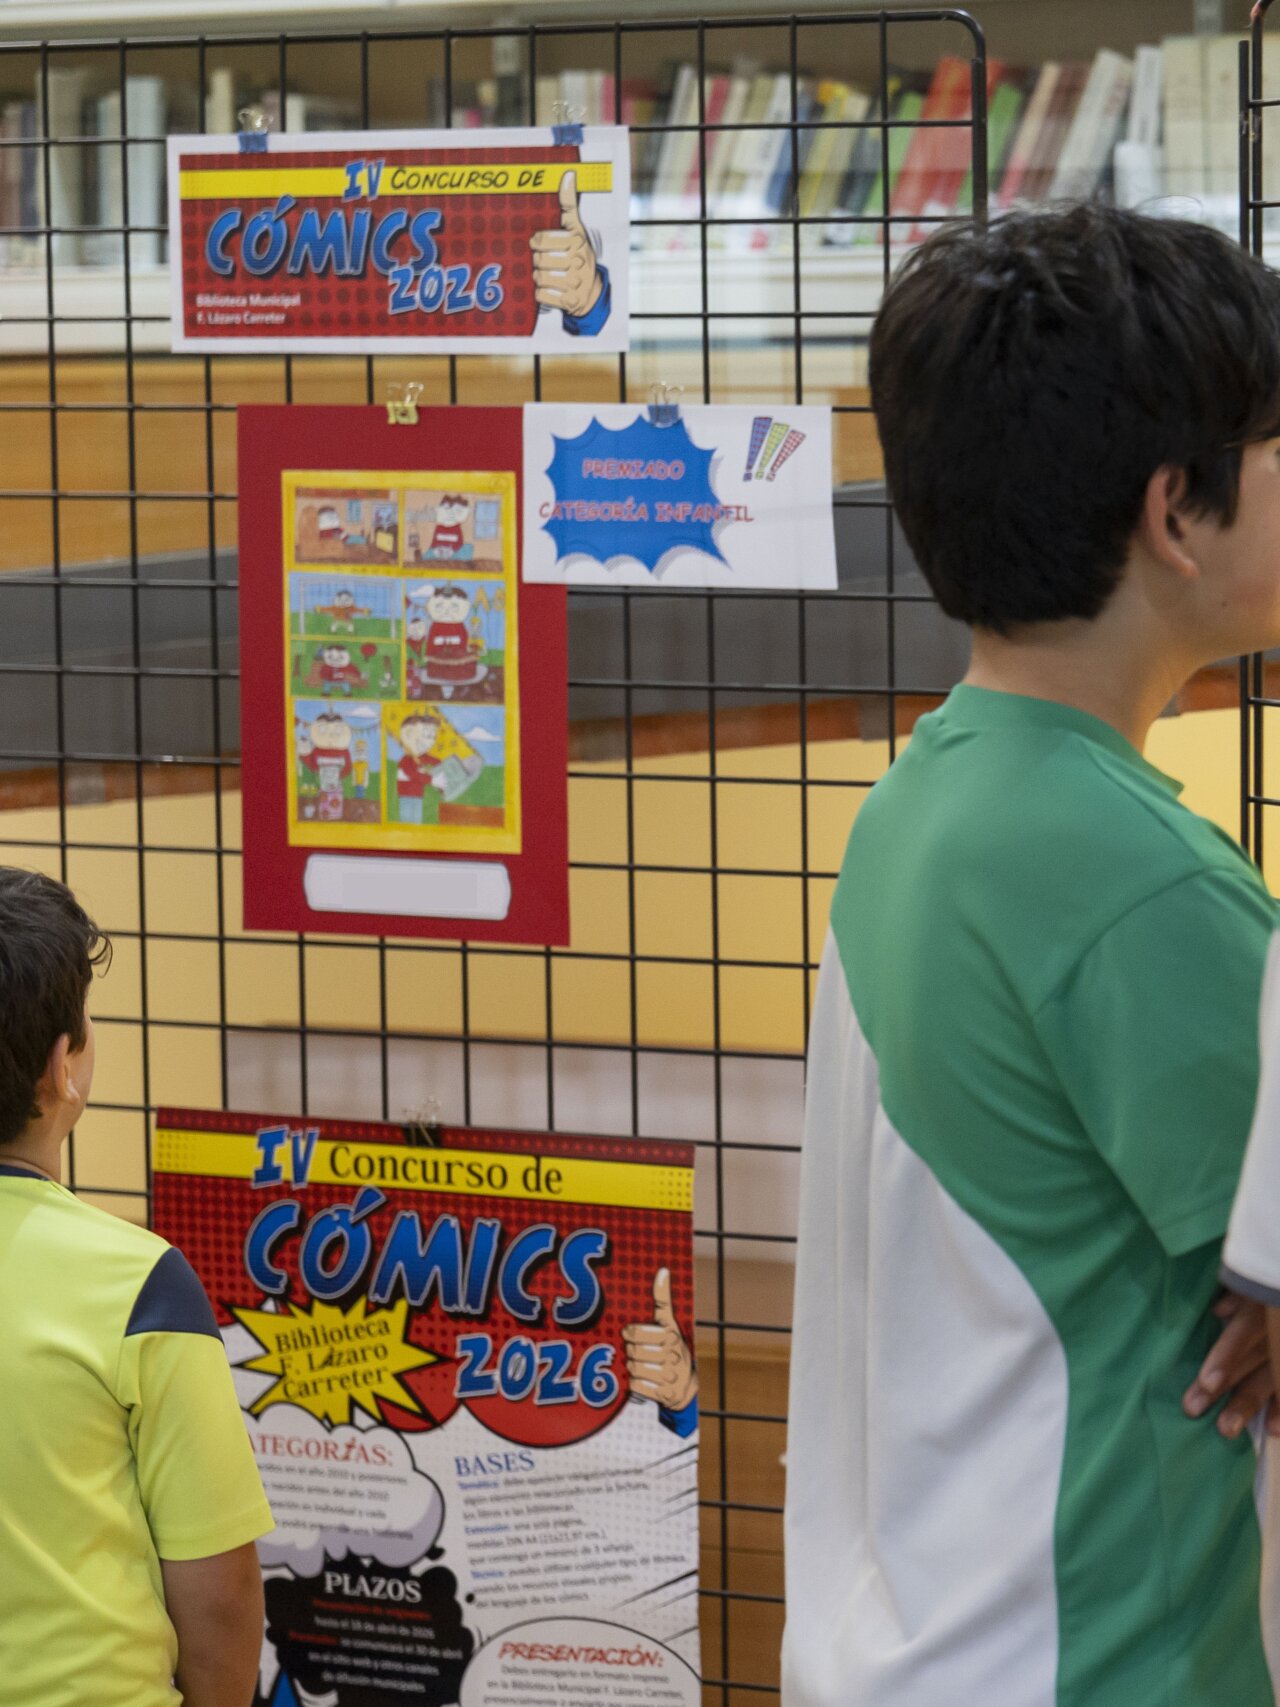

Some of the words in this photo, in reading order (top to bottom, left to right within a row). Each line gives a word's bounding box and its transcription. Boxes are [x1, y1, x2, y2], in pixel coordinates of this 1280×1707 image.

[342, 159, 386, 201] IV
[205, 194, 444, 277] CÓMICS
[196, 293, 248, 308] Biblioteca
[249, 292, 301, 309] Municipal
[387, 263, 503, 315] 2026
[243, 311, 286, 325] Carreter
[582, 458, 686, 480] PREMIADO
[539, 497, 649, 522] CATEGORÍA
[655, 502, 755, 523] INFANTIL
[252, 1126, 320, 1189] IV
[329, 1144, 508, 1193] Concurso
[523, 1155, 563, 1195] de
[244, 1184, 608, 1327] CÓMICS
[275, 1315, 391, 1356] Biblioteca
[279, 1355, 300, 1379] F.
[307, 1340, 389, 1374] Lázaro
[454, 1332, 619, 1408] 2026
[282, 1366, 386, 1401] Carreter
[247, 1433, 392, 1467] TEGORÍAS:
[454, 1450, 535, 1477] BASES
[324, 1571, 423, 1603] PLAZOS
[498, 1641, 665, 1668] PRESENTACIÓN:
